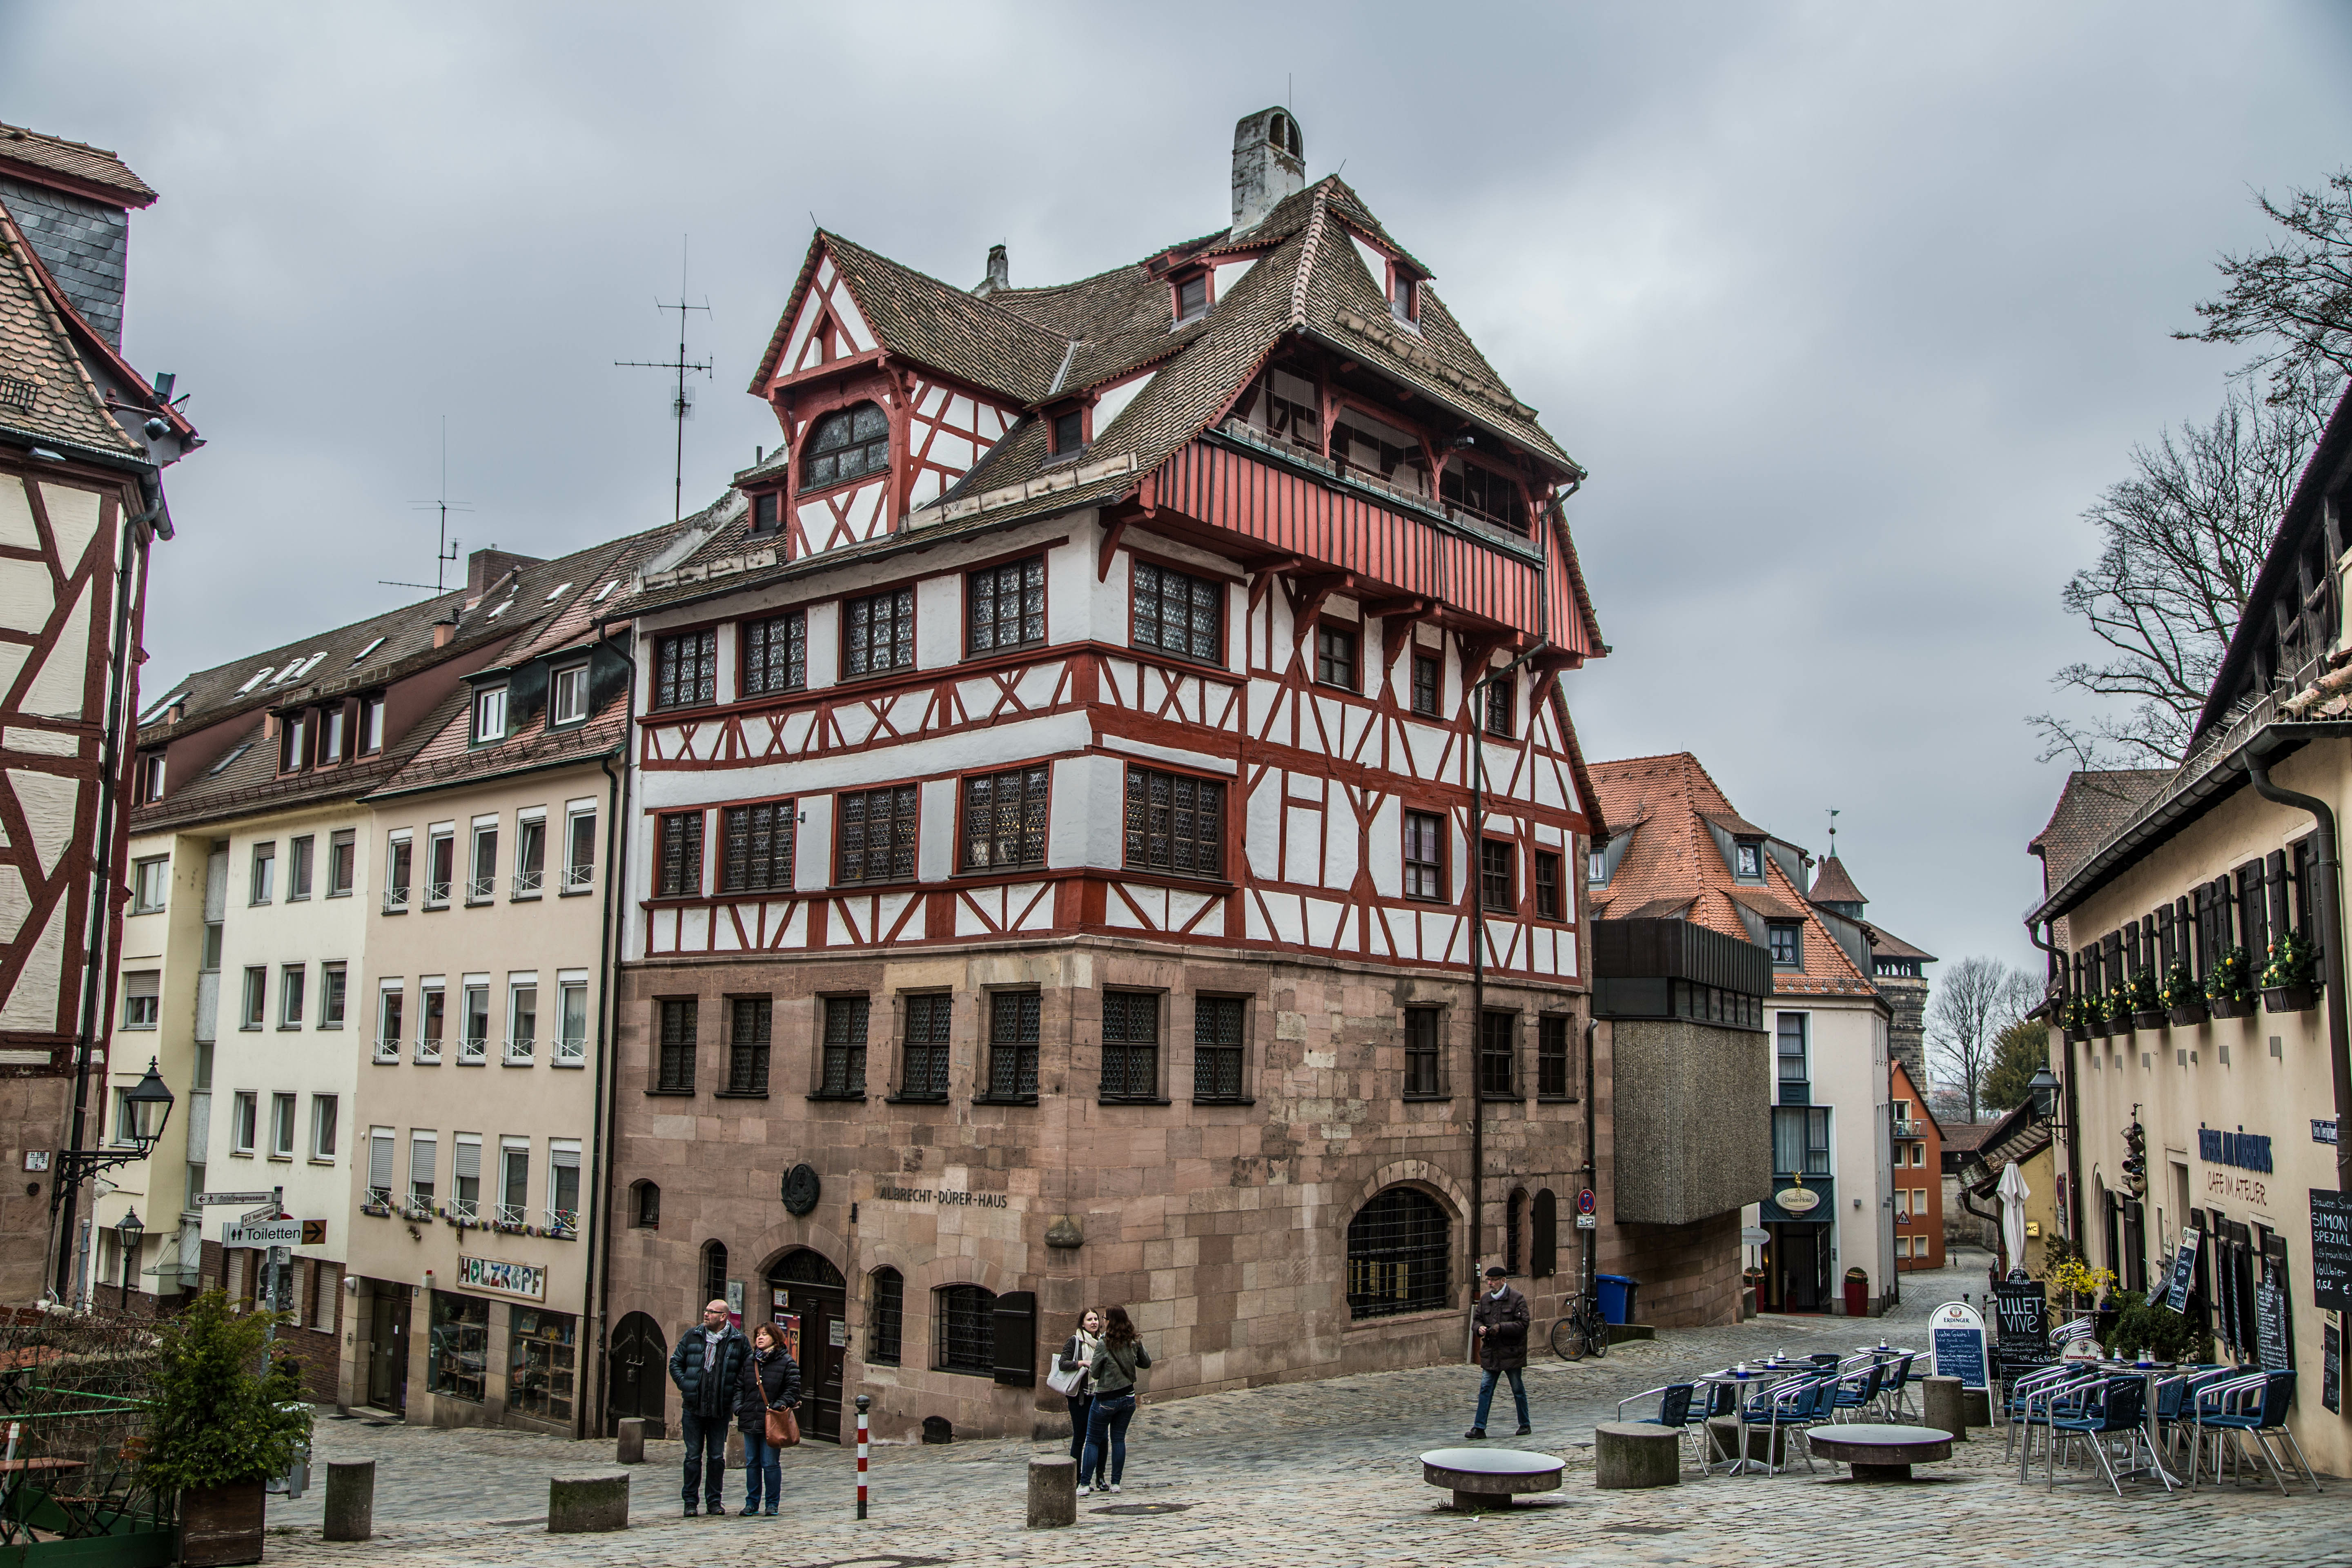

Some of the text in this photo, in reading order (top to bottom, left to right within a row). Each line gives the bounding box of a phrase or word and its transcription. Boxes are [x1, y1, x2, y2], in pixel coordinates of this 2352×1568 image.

[2208, 1167, 2267, 1206] CAFÉ IM ATELIER
[2310, 1195, 2336, 1208] Brauerei
[253, 1212, 262, 1220] Museum
[2311, 1212, 2348, 1232] SIMON
[246, 1227, 301, 1240] Toiletten
[2314, 1230, 2351, 1246] SPEZIAL
[460, 1258, 543, 1294] HOLZKOPF
[2314, 1261, 2347, 1277] Vollbier
[2316, 1278, 2333, 1291] 0,5l
[1998, 1297, 2042, 1314] LILLET
